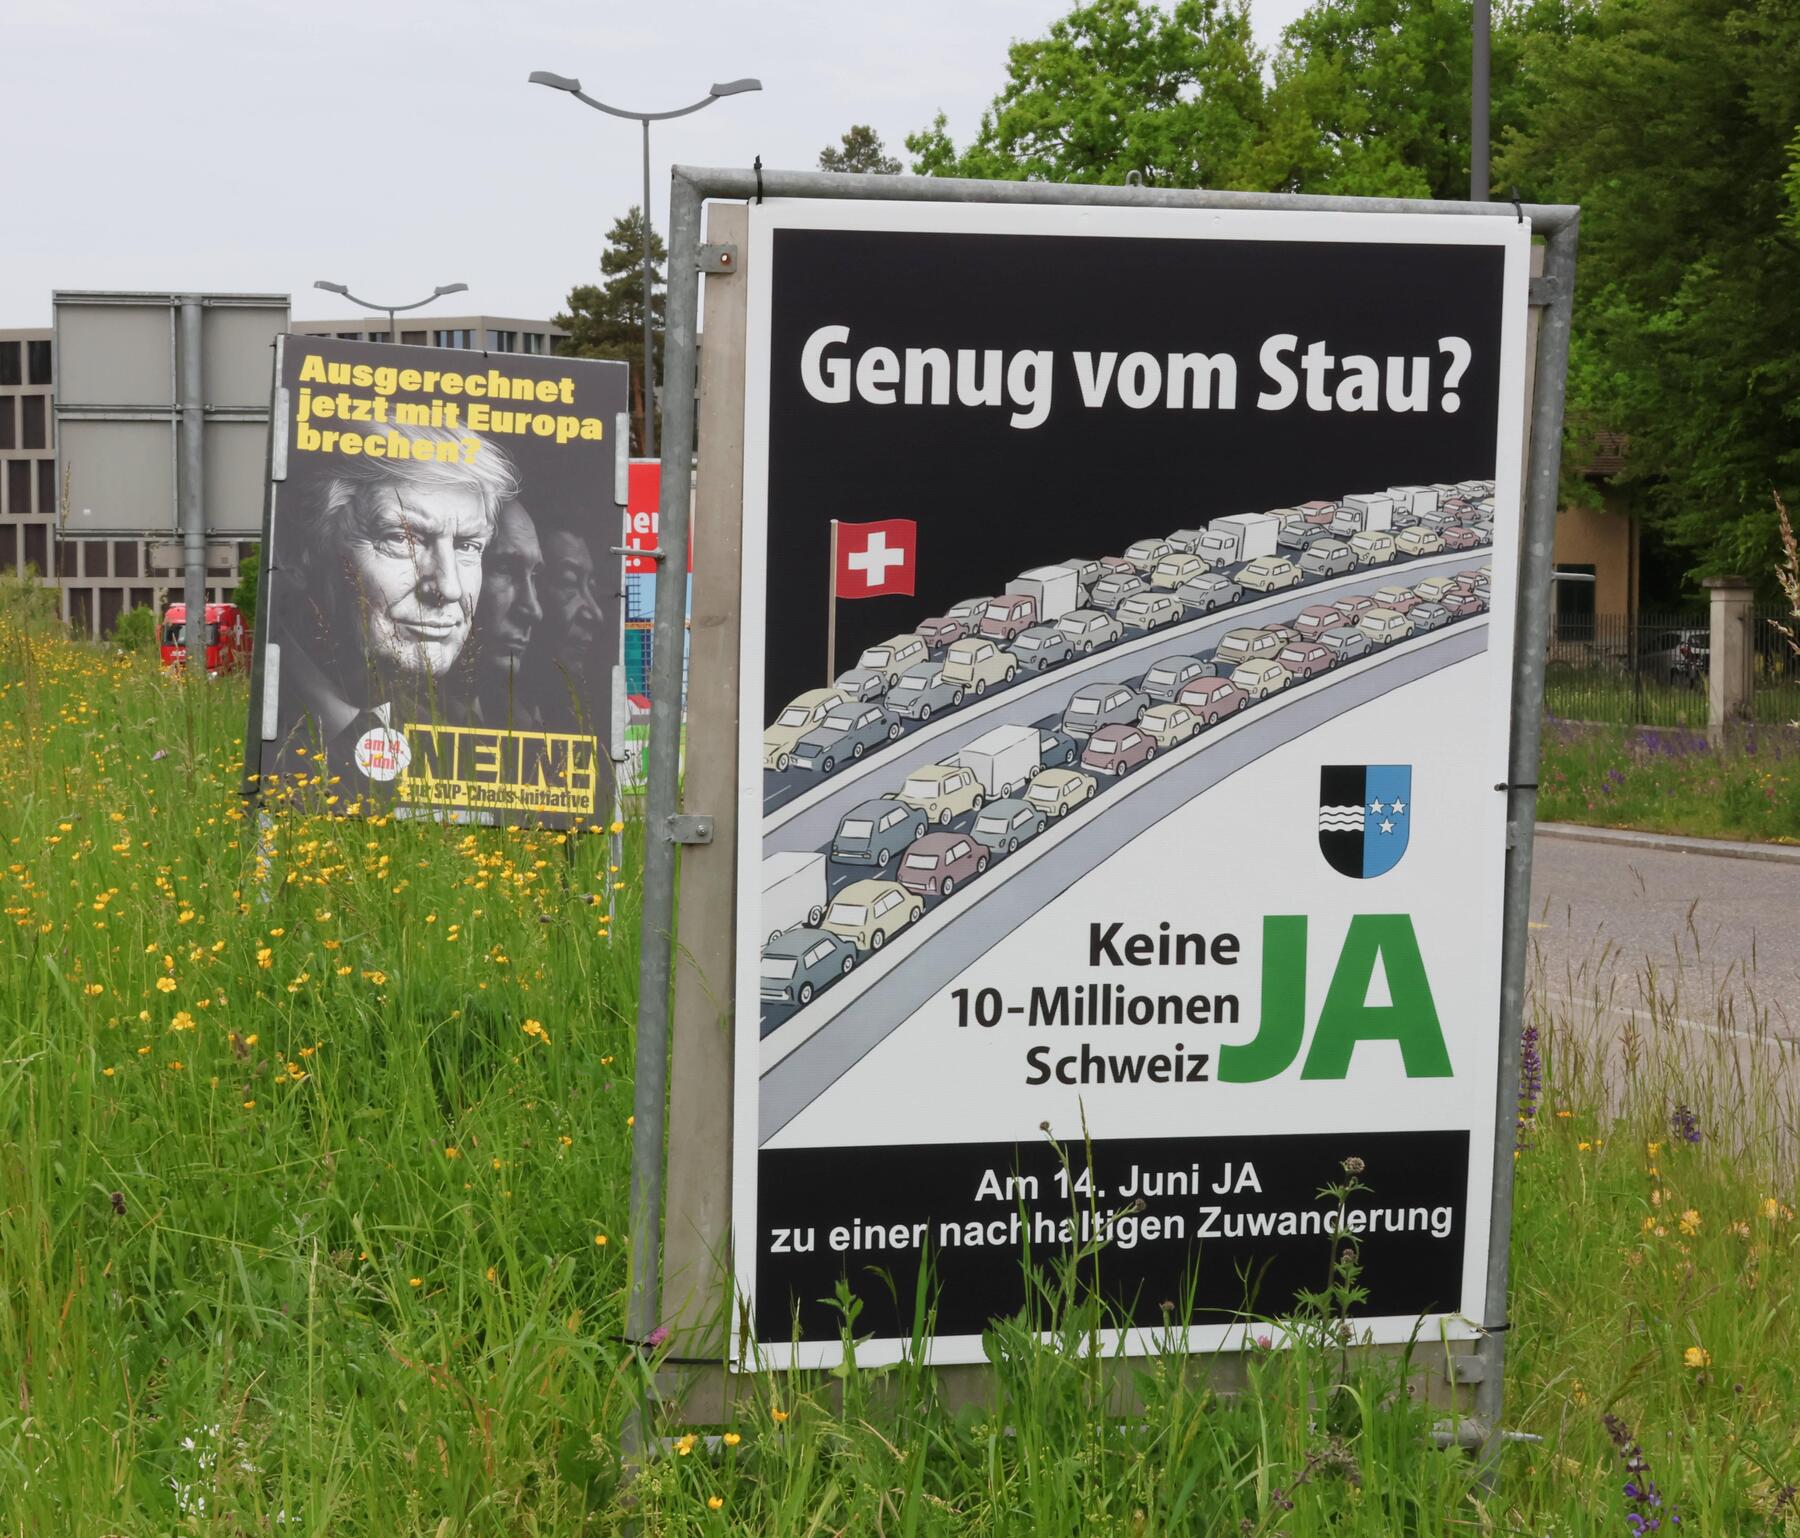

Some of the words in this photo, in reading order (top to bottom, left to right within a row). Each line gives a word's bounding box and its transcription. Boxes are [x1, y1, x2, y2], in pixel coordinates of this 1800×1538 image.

[299, 354, 575, 404] Ausgerechnet
[800, 324, 1054, 430] Genug
[1072, 351, 1238, 410] vom
[1256, 333, 1472, 414] Stau?
[296, 388, 389, 423] jetzt
[395, 399, 460, 430] mit
[466, 403, 604, 444] Europa
[296, 421, 481, 464] brechen?
[364, 739, 384, 751] am
[407, 730, 592, 789] NEIN!
[1089, 921, 1240, 967] Keine
[951, 983, 1239, 1028] 10-Millionen
[1217, 914, 1454, 1083] JA
[1025, 1043, 1209, 1086] Schweiz
[974, 1169, 1039, 1202] Am
[1053, 1166, 1106, 1199] 14.
[1118, 1163, 1200, 1198] Juni
[1211, 1161, 1263, 1195] JA
[770, 1227, 815, 1253] zu
[828, 1217, 928, 1251] einer
[940, 1206, 1186, 1250] nachhaltigen
[1197, 1203, 1453, 1239] Zuwanderung
